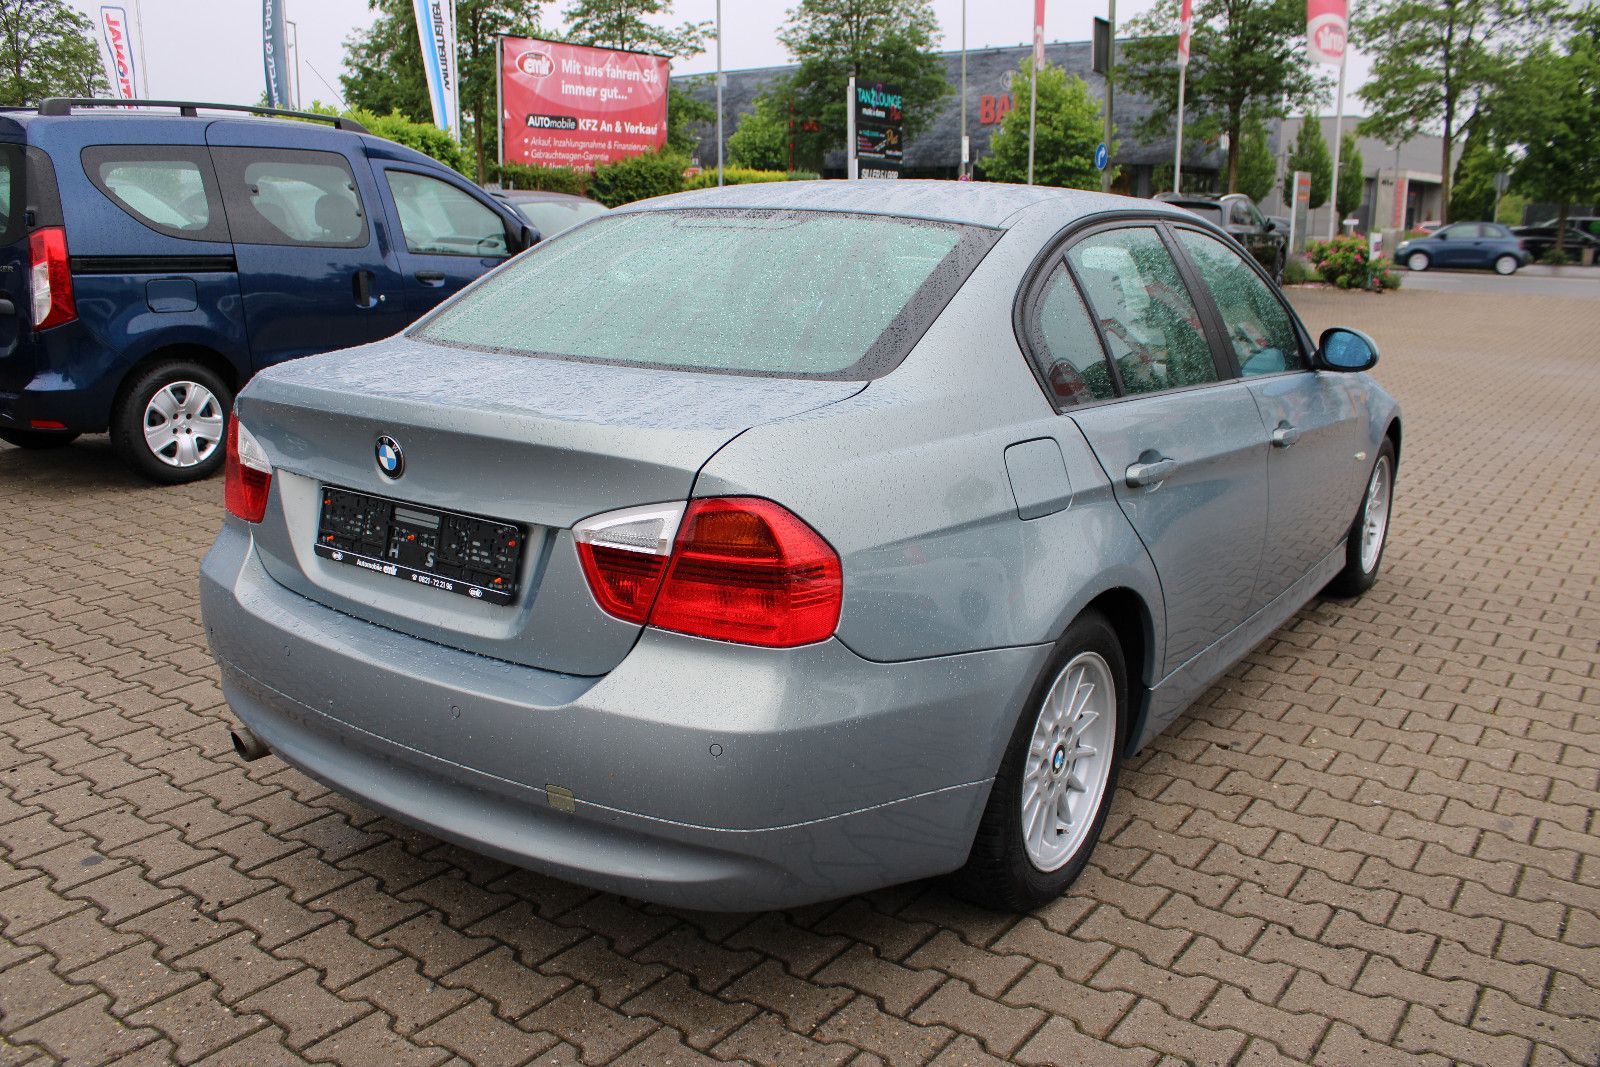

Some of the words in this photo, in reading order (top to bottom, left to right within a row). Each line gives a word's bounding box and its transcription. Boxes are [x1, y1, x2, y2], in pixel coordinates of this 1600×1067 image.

[561, 59, 581, 75] Mit
[584, 65, 604, 78] uns
[605, 64, 639, 82] fahren
[642, 68, 658, 84] Sie
[561, 80, 597, 97] immer
[527, 115, 576, 130] AUTOmobile
[578, 118, 598, 131] KFZ
[600, 120, 613, 133] An
[614, 121, 622, 133] &
[624, 122, 658, 135] Verkauf
[356, 558, 382, 572] Automobile
